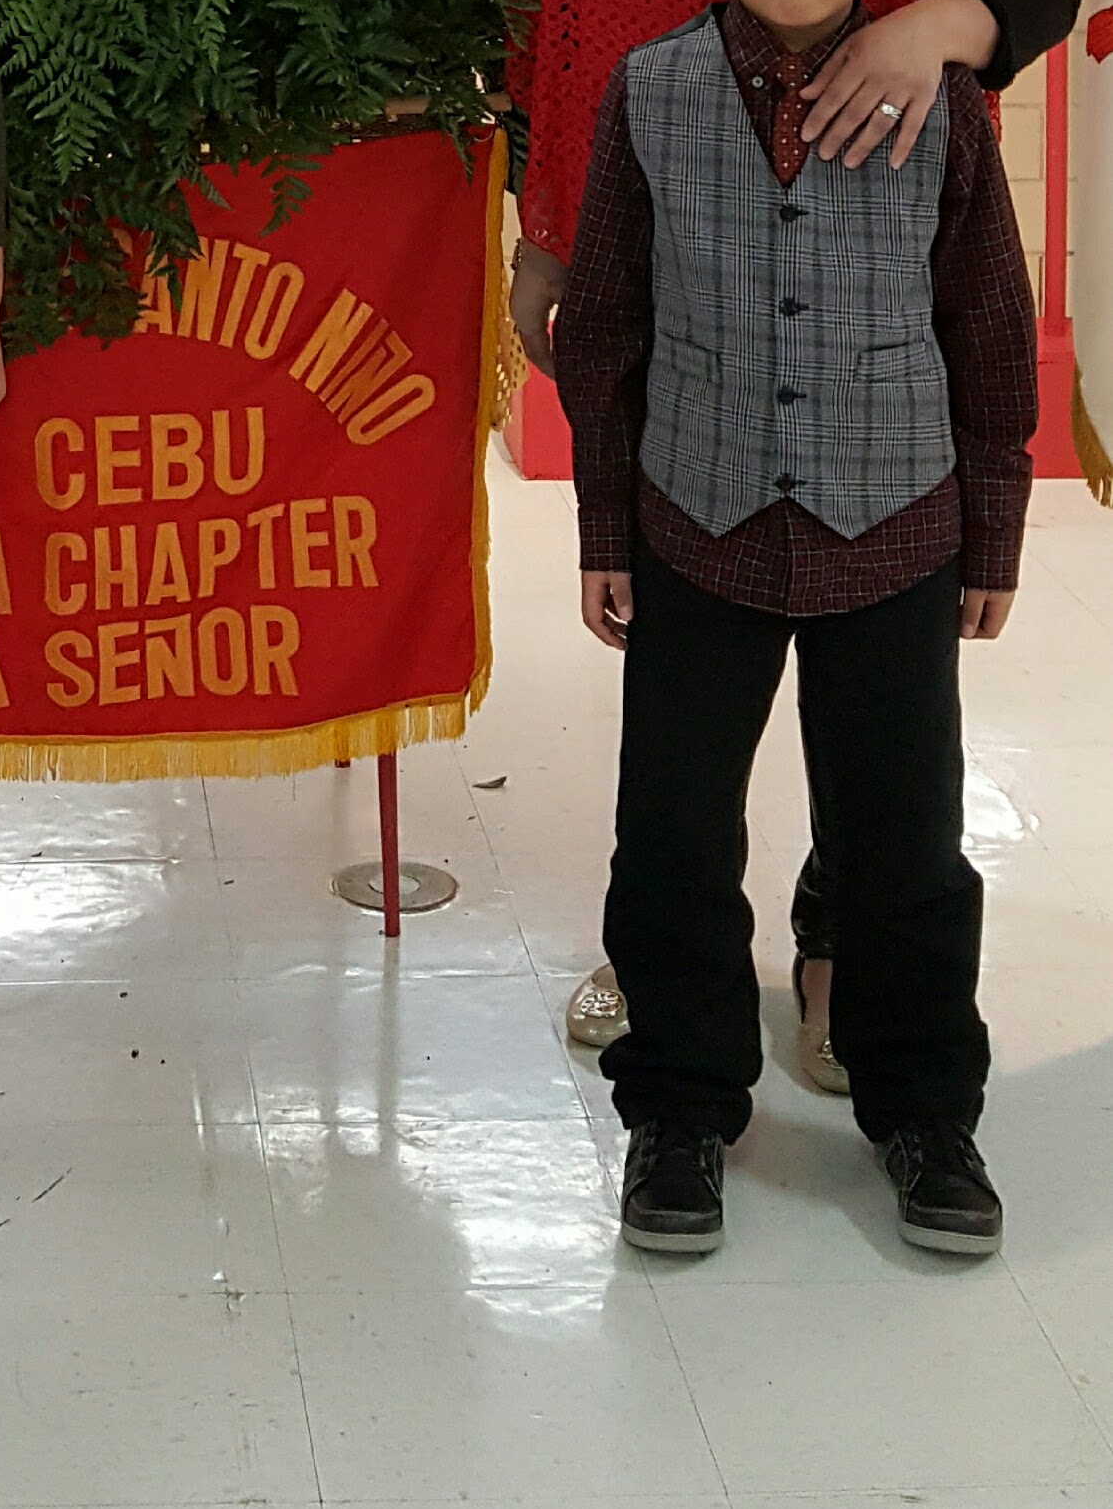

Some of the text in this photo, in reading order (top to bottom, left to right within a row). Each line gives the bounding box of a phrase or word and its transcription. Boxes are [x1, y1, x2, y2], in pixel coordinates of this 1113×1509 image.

[112, 227, 436, 445] ANTO NIÑO
[34, 406, 265, 511] CEBU
[44, 495, 379, 616] CHAPTER
[44, 604, 300, 708] SEÑOR
